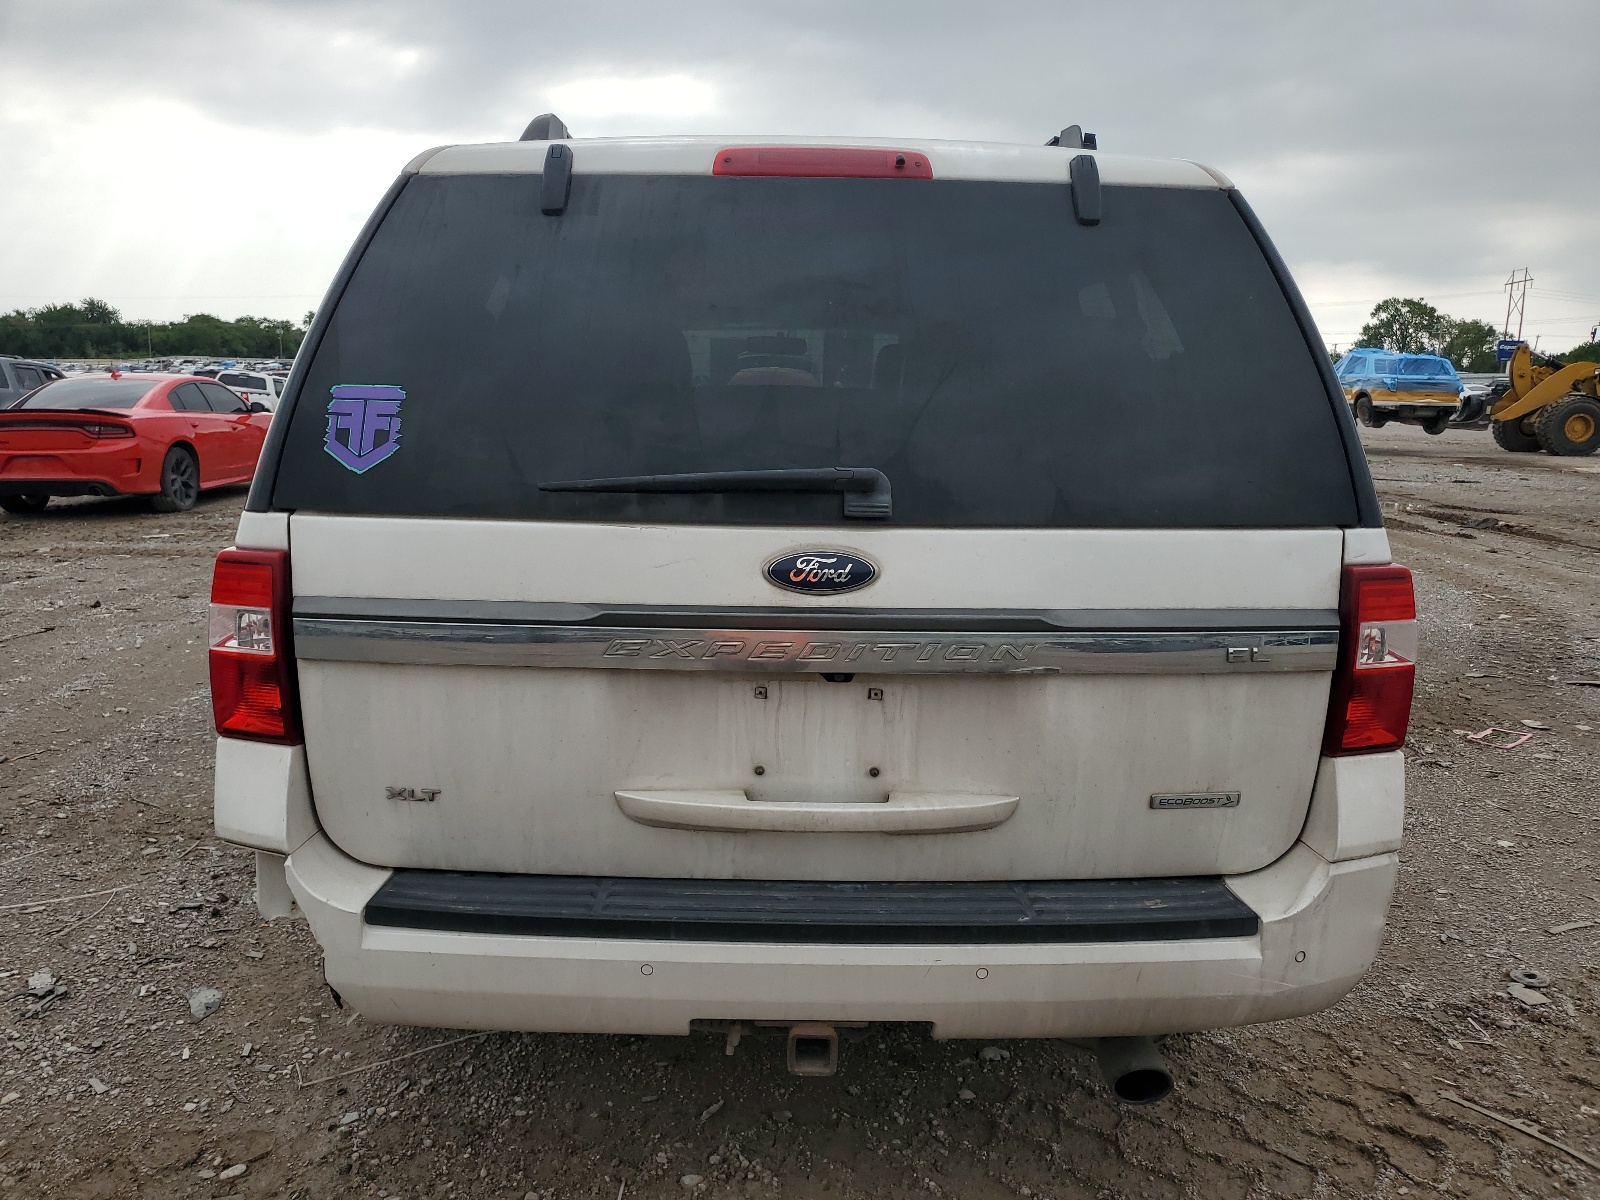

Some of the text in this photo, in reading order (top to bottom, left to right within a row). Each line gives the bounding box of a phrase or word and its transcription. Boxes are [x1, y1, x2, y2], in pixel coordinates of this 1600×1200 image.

[789, 555, 852, 583] Ford
[602, 637, 1039, 663] EXPEDITION
[1226, 646, 1271, 663] EL
[385, 786, 442, 802] XLT
